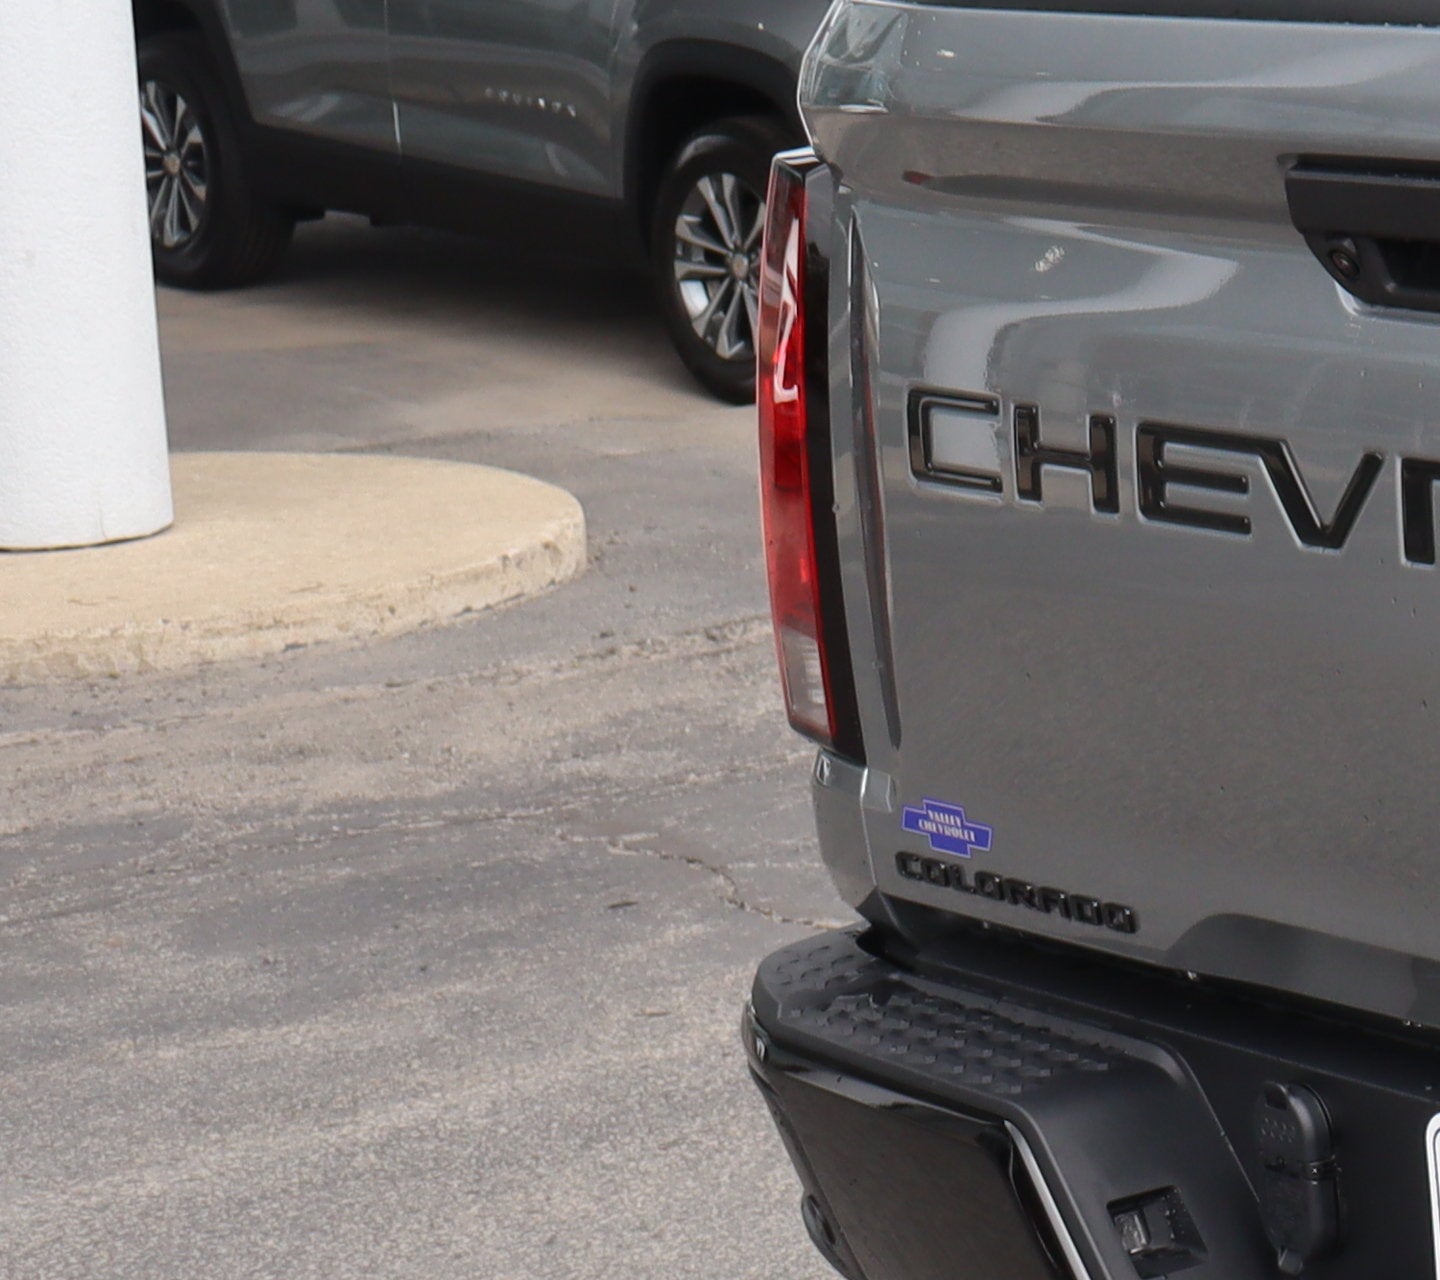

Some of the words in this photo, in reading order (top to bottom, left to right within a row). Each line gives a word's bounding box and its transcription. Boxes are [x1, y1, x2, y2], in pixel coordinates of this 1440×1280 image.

[927, 809, 962, 827] VALLEY
[918, 819, 976, 842] CHEVROLET
[894, 850, 1140, 934] COLORADO
